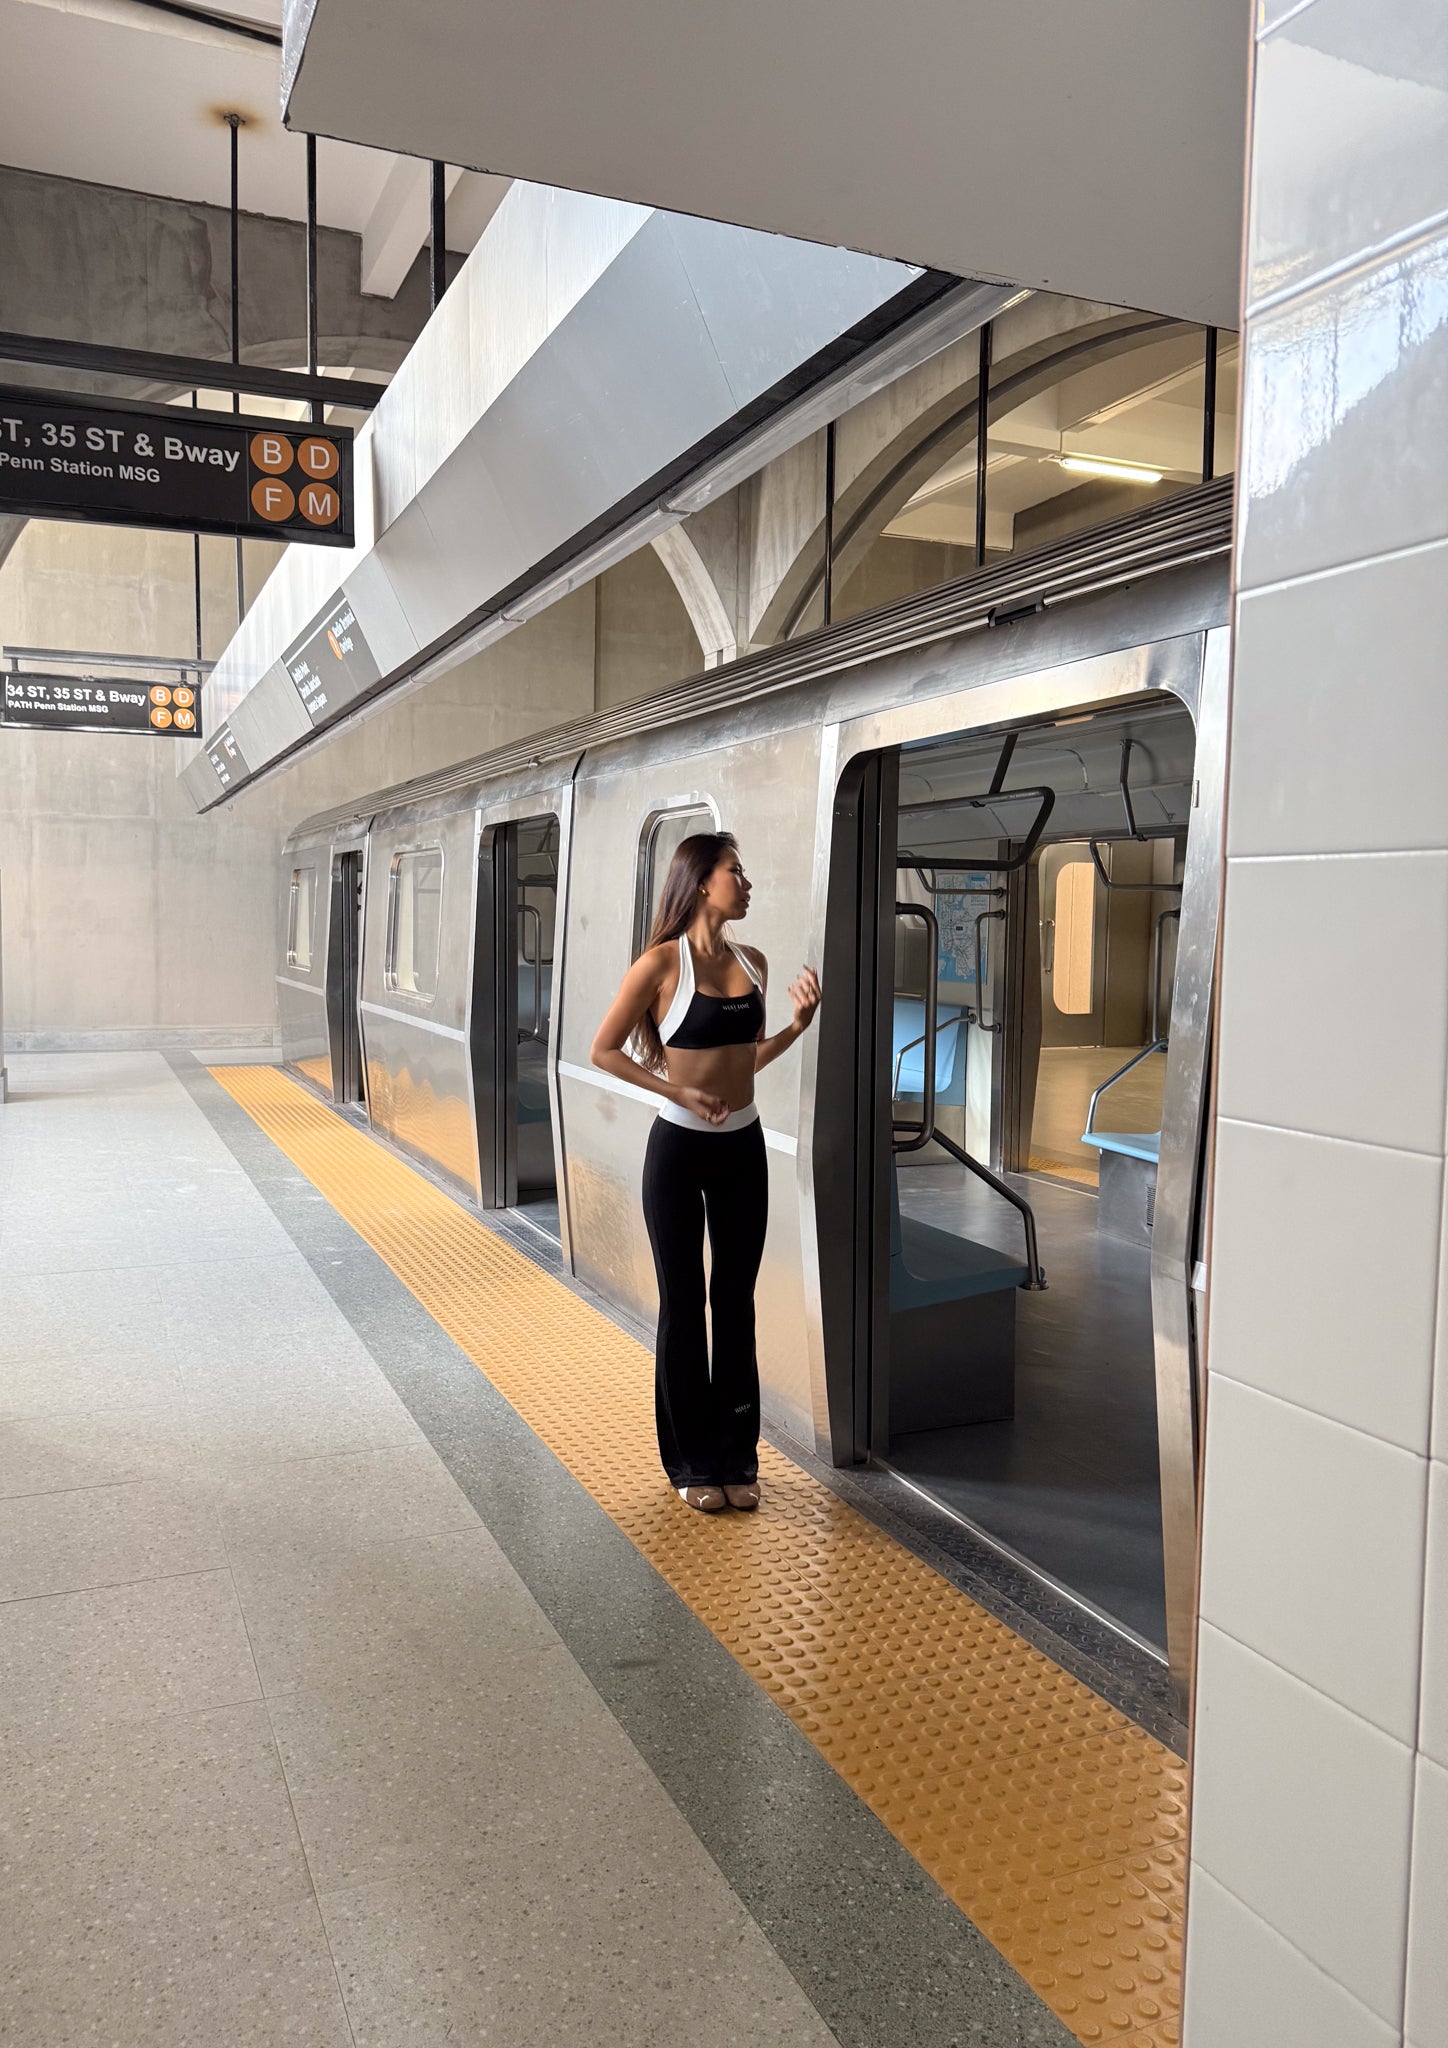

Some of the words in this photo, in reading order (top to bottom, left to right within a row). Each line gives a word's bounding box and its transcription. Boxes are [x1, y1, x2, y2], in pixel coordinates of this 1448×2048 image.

[0, 418, 31, 448] T,
[41, 423, 76, 448] 35
[85, 427, 125, 453] ST
[133, 433, 155, 458] &
[164, 436, 240, 472] Bway
[263, 439, 283, 465] B
[310, 445, 331, 470] D
[0, 452, 44, 471] Penn
[50, 457, 114, 478] Station
[119, 464, 160, 483] MSG
[265, 487, 283, 512] F
[308, 491, 331, 517] M
[7, 684, 24, 697] 34
[27, 685, 50, 700] ST,
[53, 687, 71, 699] 35
[73, 688, 92, 701] ST
[95, 689, 107, 702] &
[109, 690, 146, 706] Bway
[8, 700, 32, 709] PATH
[34, 701, 56, 710] Penn
[57, 702, 87, 712] Station
[88, 704, 109, 713] MSG
[155, 689, 167, 702] B
[178, 690, 190, 704] D
[156, 711, 167, 723] F
[177, 712, 191, 725] M
